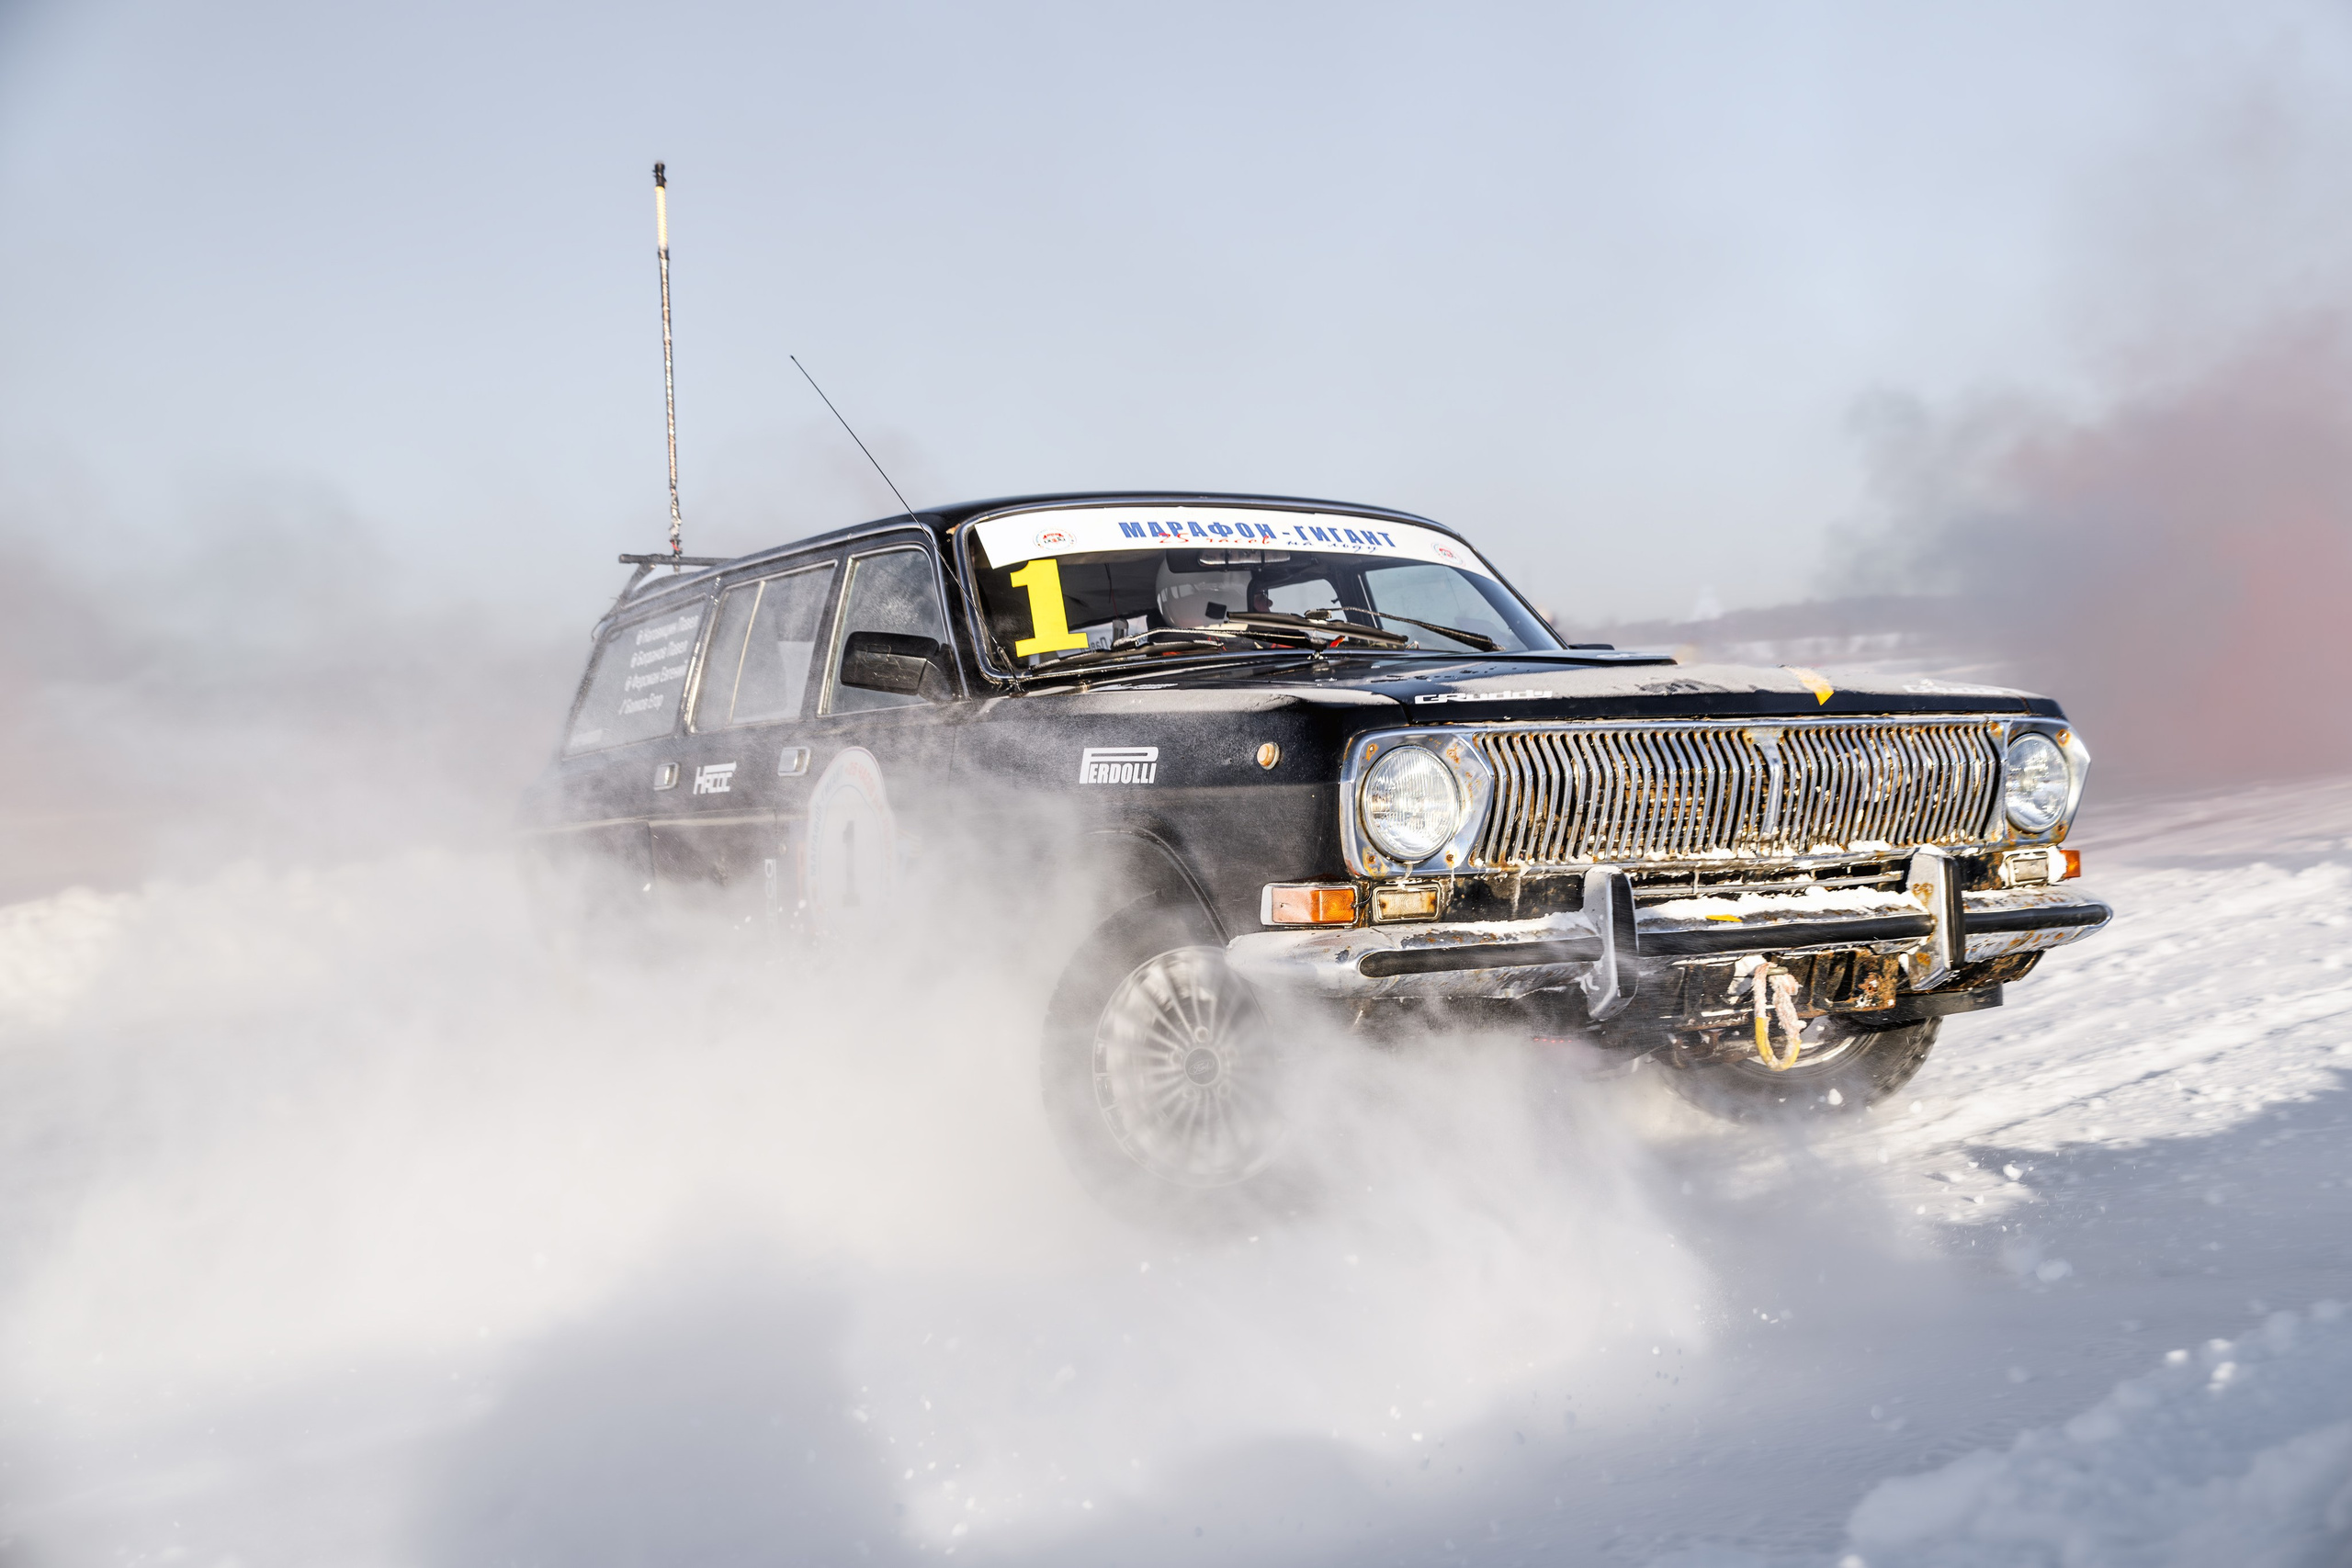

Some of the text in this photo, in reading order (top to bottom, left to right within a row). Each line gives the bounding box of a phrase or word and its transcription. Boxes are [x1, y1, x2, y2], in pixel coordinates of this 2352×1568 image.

[1158, 532, 1189, 544] 25
[1010, 558, 1090, 658] 1
[1079, 746, 1159, 784] PERDOLLI
[842, 819, 861, 908] 1
